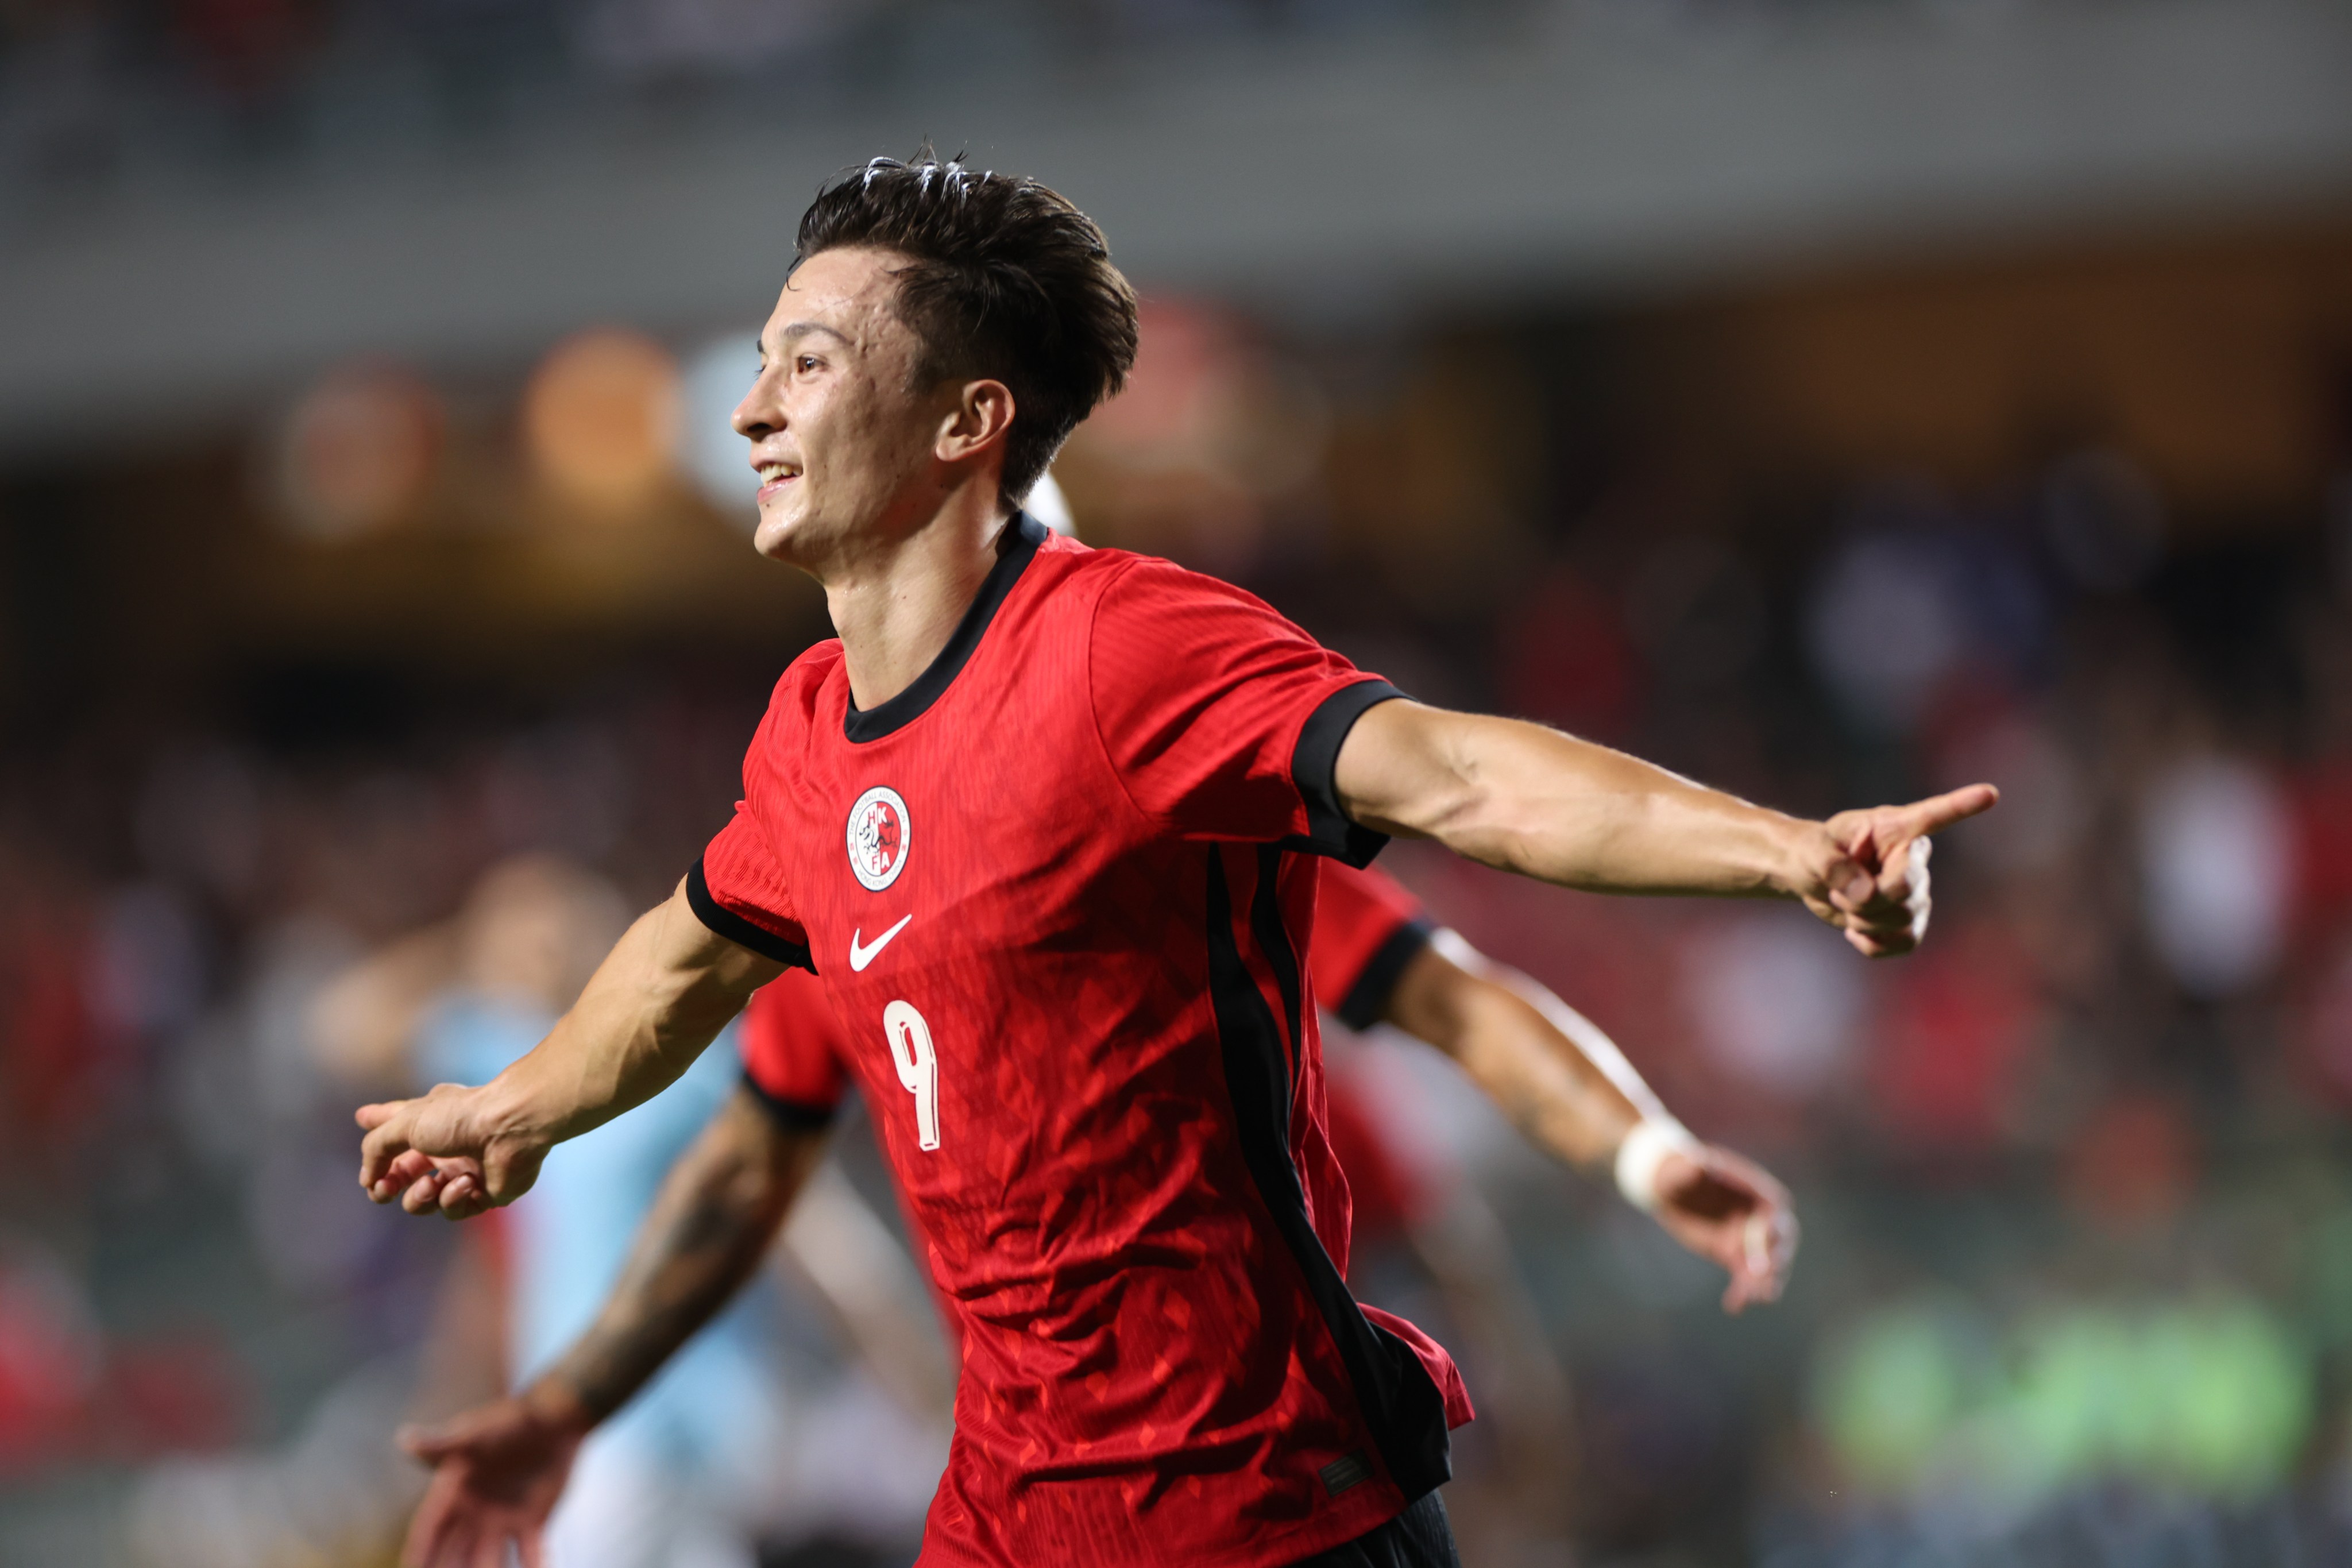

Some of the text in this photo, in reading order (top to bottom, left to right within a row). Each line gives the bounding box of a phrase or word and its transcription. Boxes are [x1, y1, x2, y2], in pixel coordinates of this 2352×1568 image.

[853, 792, 876, 818] FOOTBALL
[879, 791, 906, 822] ASSOCIATION
[867, 806, 887, 825] HK
[872, 852, 890, 870] FA
[859, 870, 871, 885] HONG
[883, 999, 940, 1152] 9
